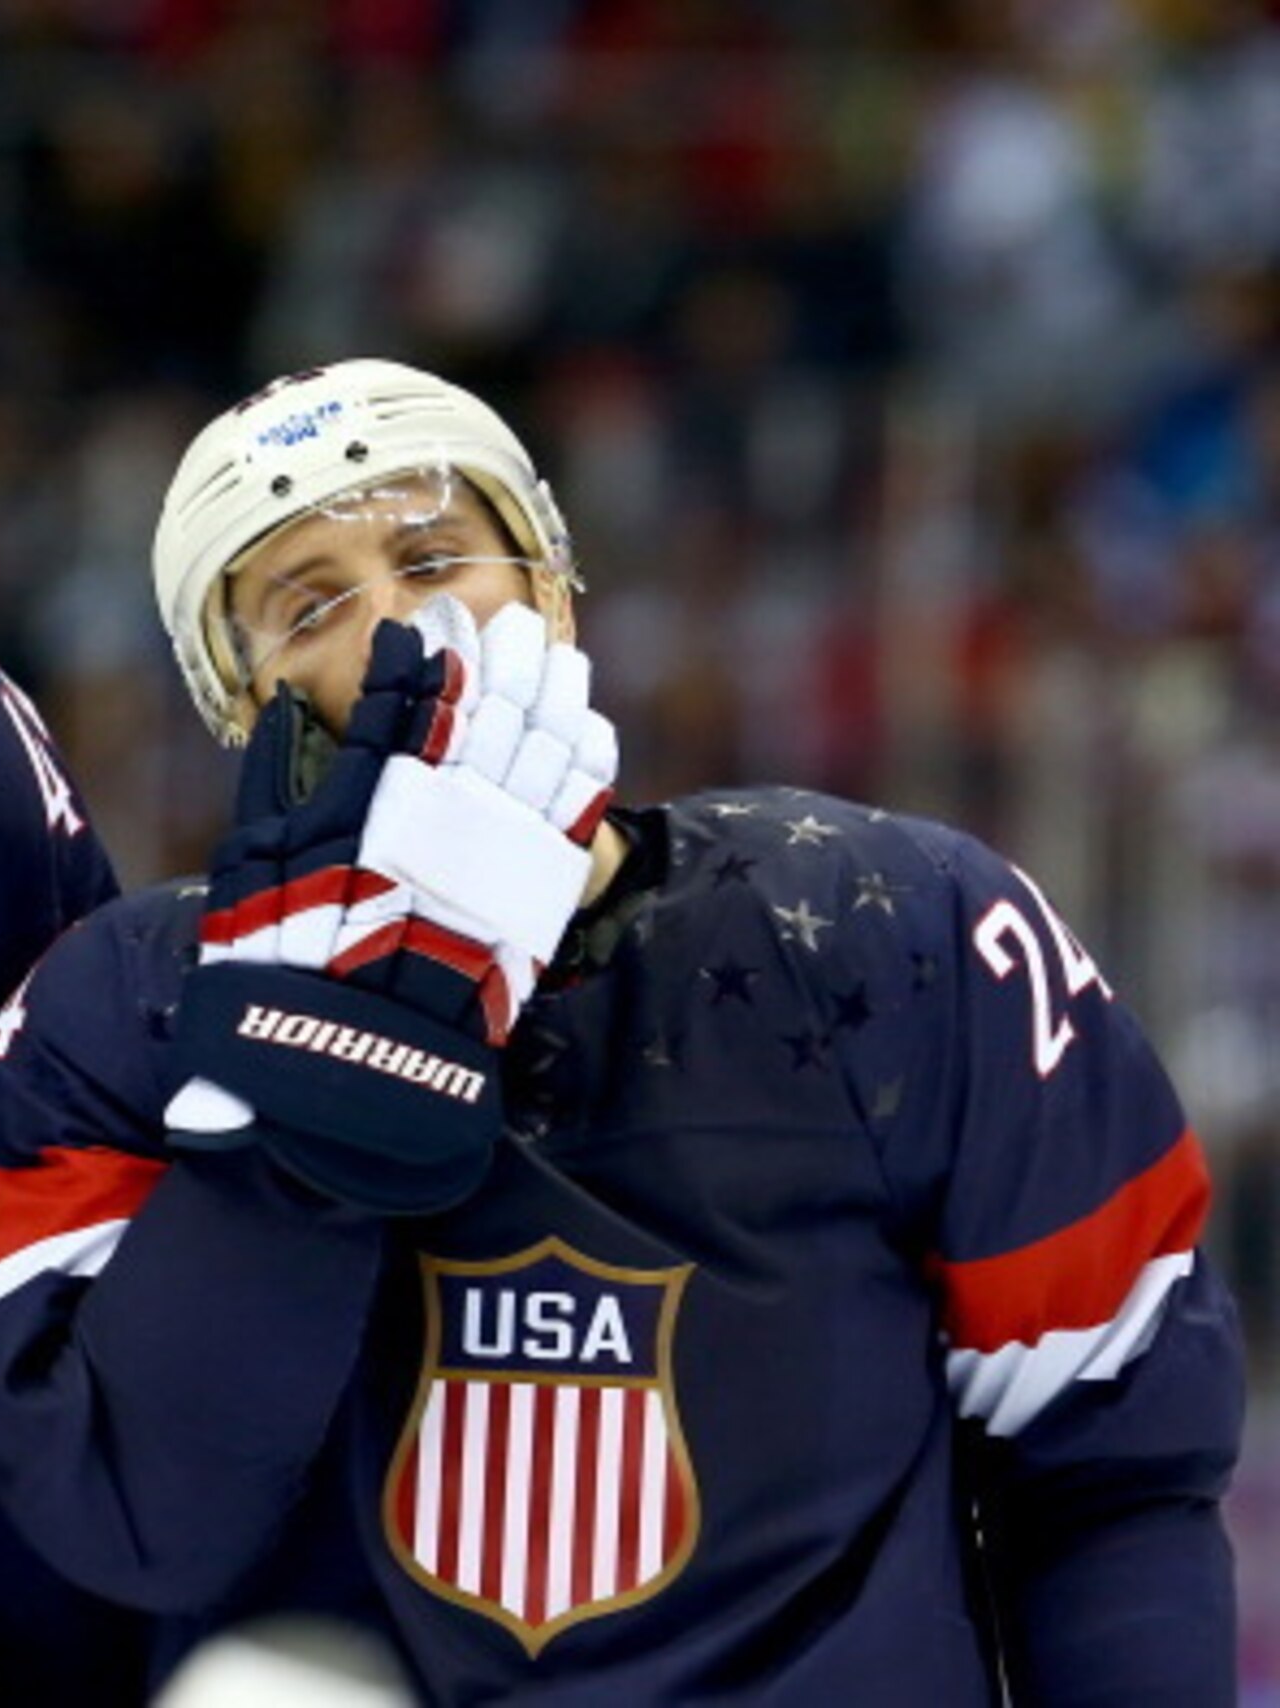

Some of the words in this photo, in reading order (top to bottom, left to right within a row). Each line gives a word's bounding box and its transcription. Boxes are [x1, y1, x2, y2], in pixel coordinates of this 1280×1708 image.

[973, 862, 1113, 1078] 24
[237, 1003, 486, 1104] WARRIOR
[462, 1288, 632, 1363] USA
